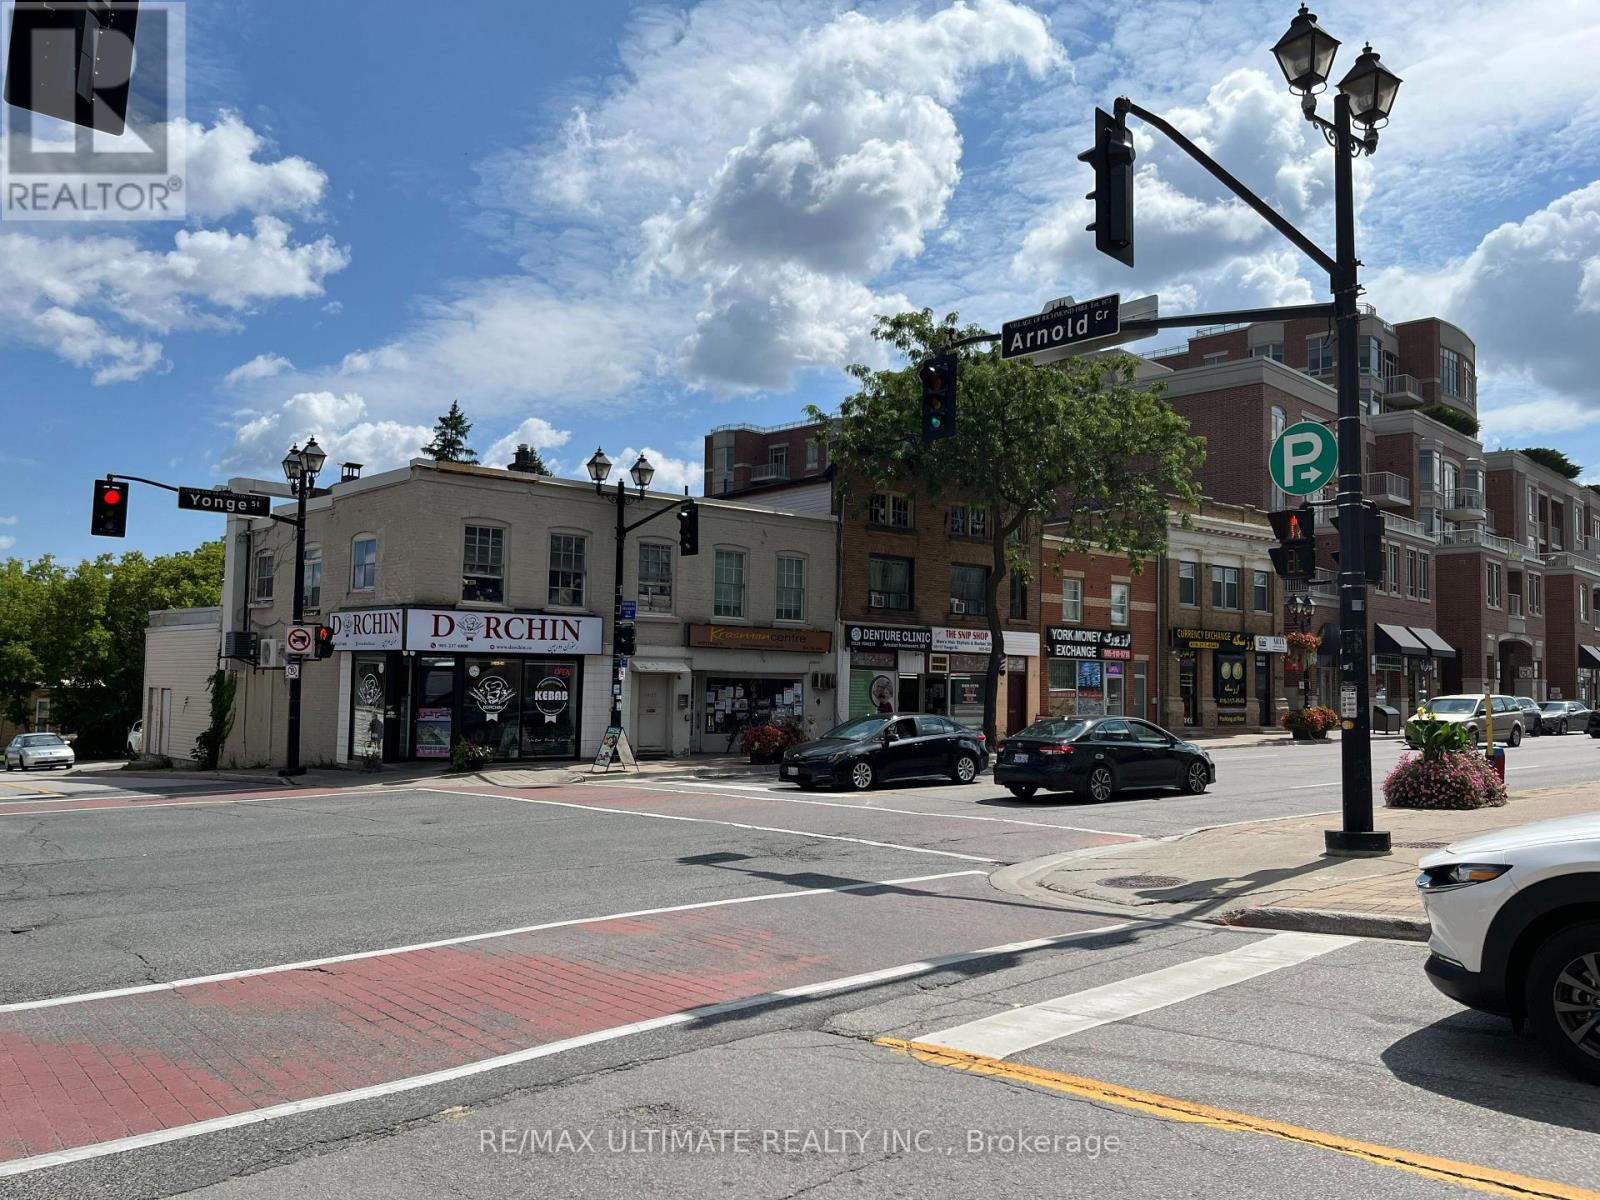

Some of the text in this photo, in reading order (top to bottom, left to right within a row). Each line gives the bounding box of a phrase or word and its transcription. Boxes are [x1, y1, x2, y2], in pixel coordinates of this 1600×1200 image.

[1009, 319, 1033, 329] VILLAGE
[1033, 316, 1042, 324] OF
[1041, 307, 1075, 321] RICHMOND
[1075, 303, 1089, 313] HILL
[1010, 310, 1109, 352] Arnold Cr
[191, 494, 247, 512] Yonge
[250, 500, 260, 508] St
[770, 634, 806, 643] centre
[863, 629, 931, 643] DENTURE CLINIC
[945, 630, 989, 640] THE SNIP SHOP
[1051, 628, 1102, 643] YORK MONEY
[1176, 628, 1231, 641] CURRENCY EXCHANGE
[1056, 644, 1097, 657] EXCHANGE
[553, 666, 573, 678] OPEN
[534, 690, 569, 701] KEBAB
